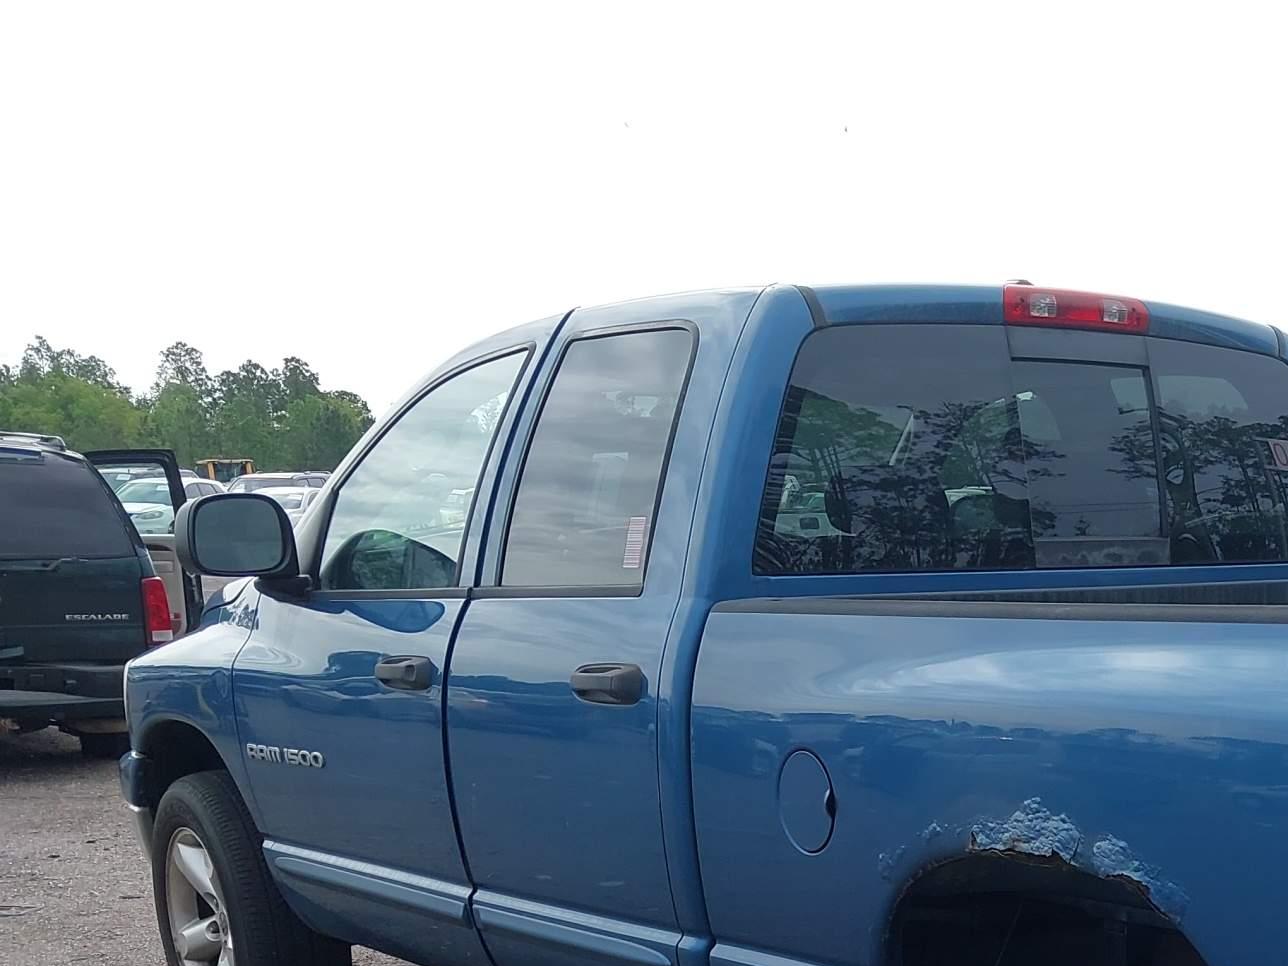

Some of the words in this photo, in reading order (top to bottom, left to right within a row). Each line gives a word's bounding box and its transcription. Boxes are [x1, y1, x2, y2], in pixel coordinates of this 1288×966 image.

[65, 613, 129, 621] ESCALADE
[246, 743, 281, 763] RAM
[282, 747, 325, 768] 1500
